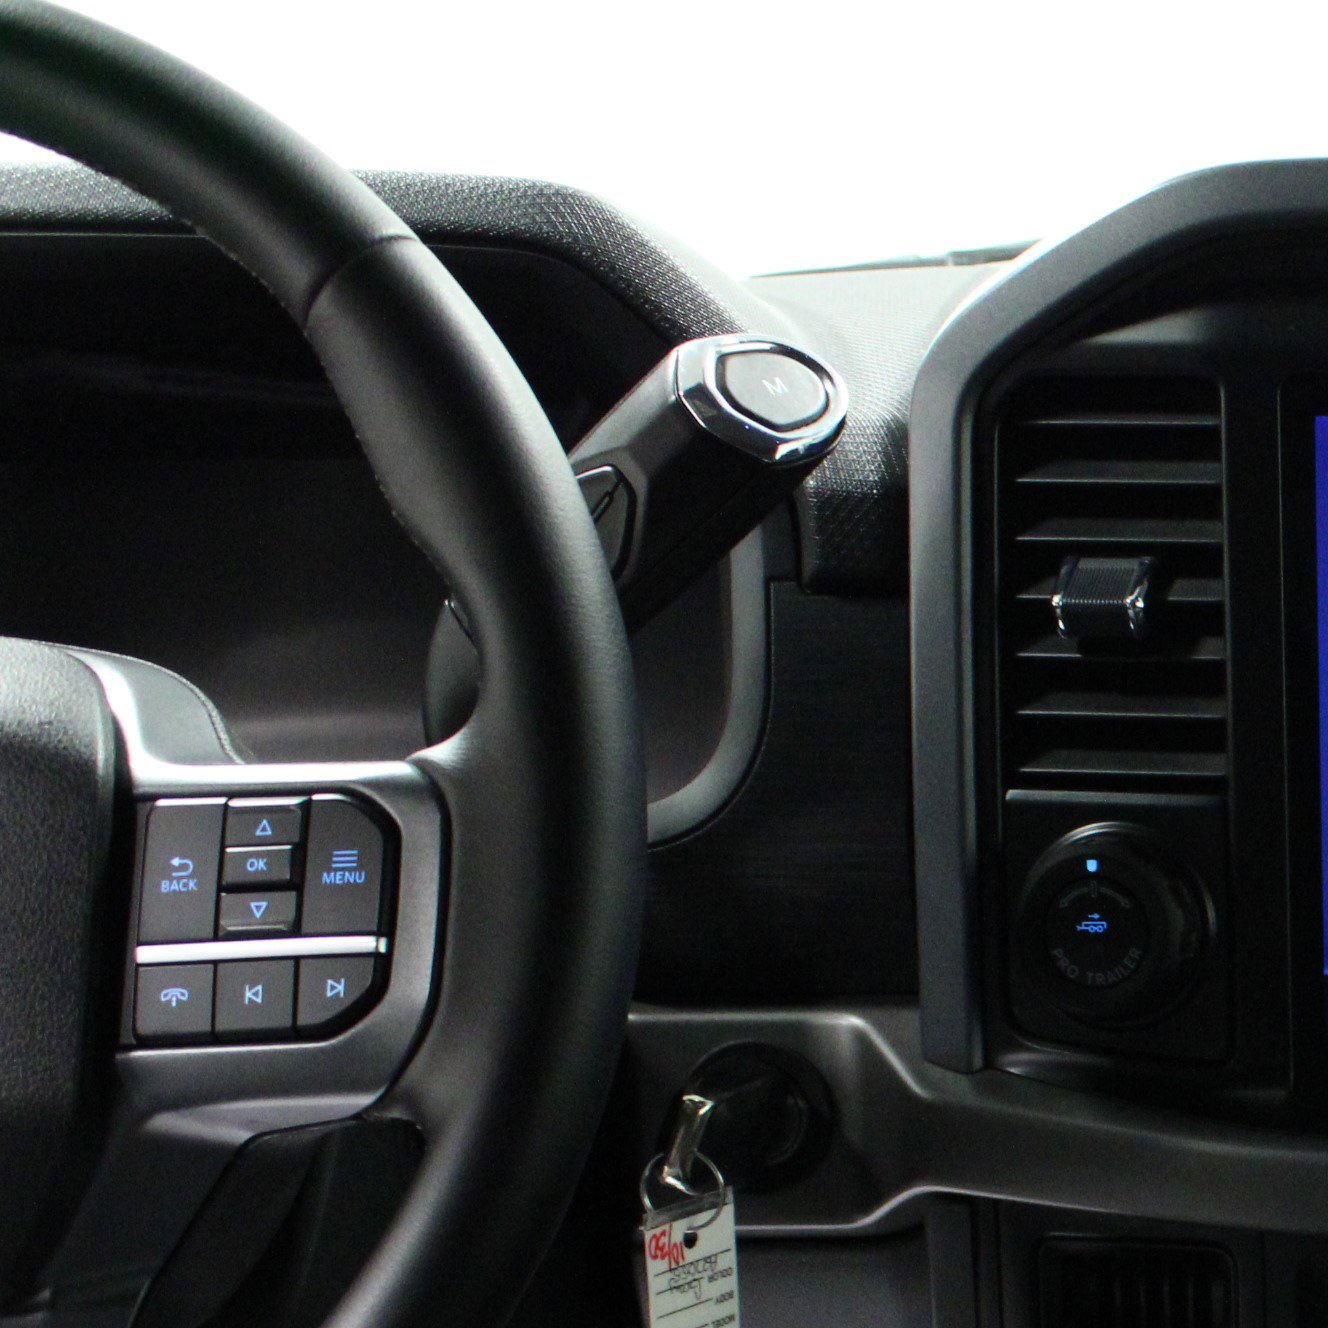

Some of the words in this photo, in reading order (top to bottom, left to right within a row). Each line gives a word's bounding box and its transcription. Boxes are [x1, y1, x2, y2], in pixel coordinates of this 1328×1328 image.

[761, 376, 789, 396] M
[247, 859, 266, 871] OK
[322, 872, 364, 884] MENU
[161, 879, 196, 892] BACK
[1052, 949, 1080, 978] PRO
[1086, 948, 1143, 986] TRAILER
